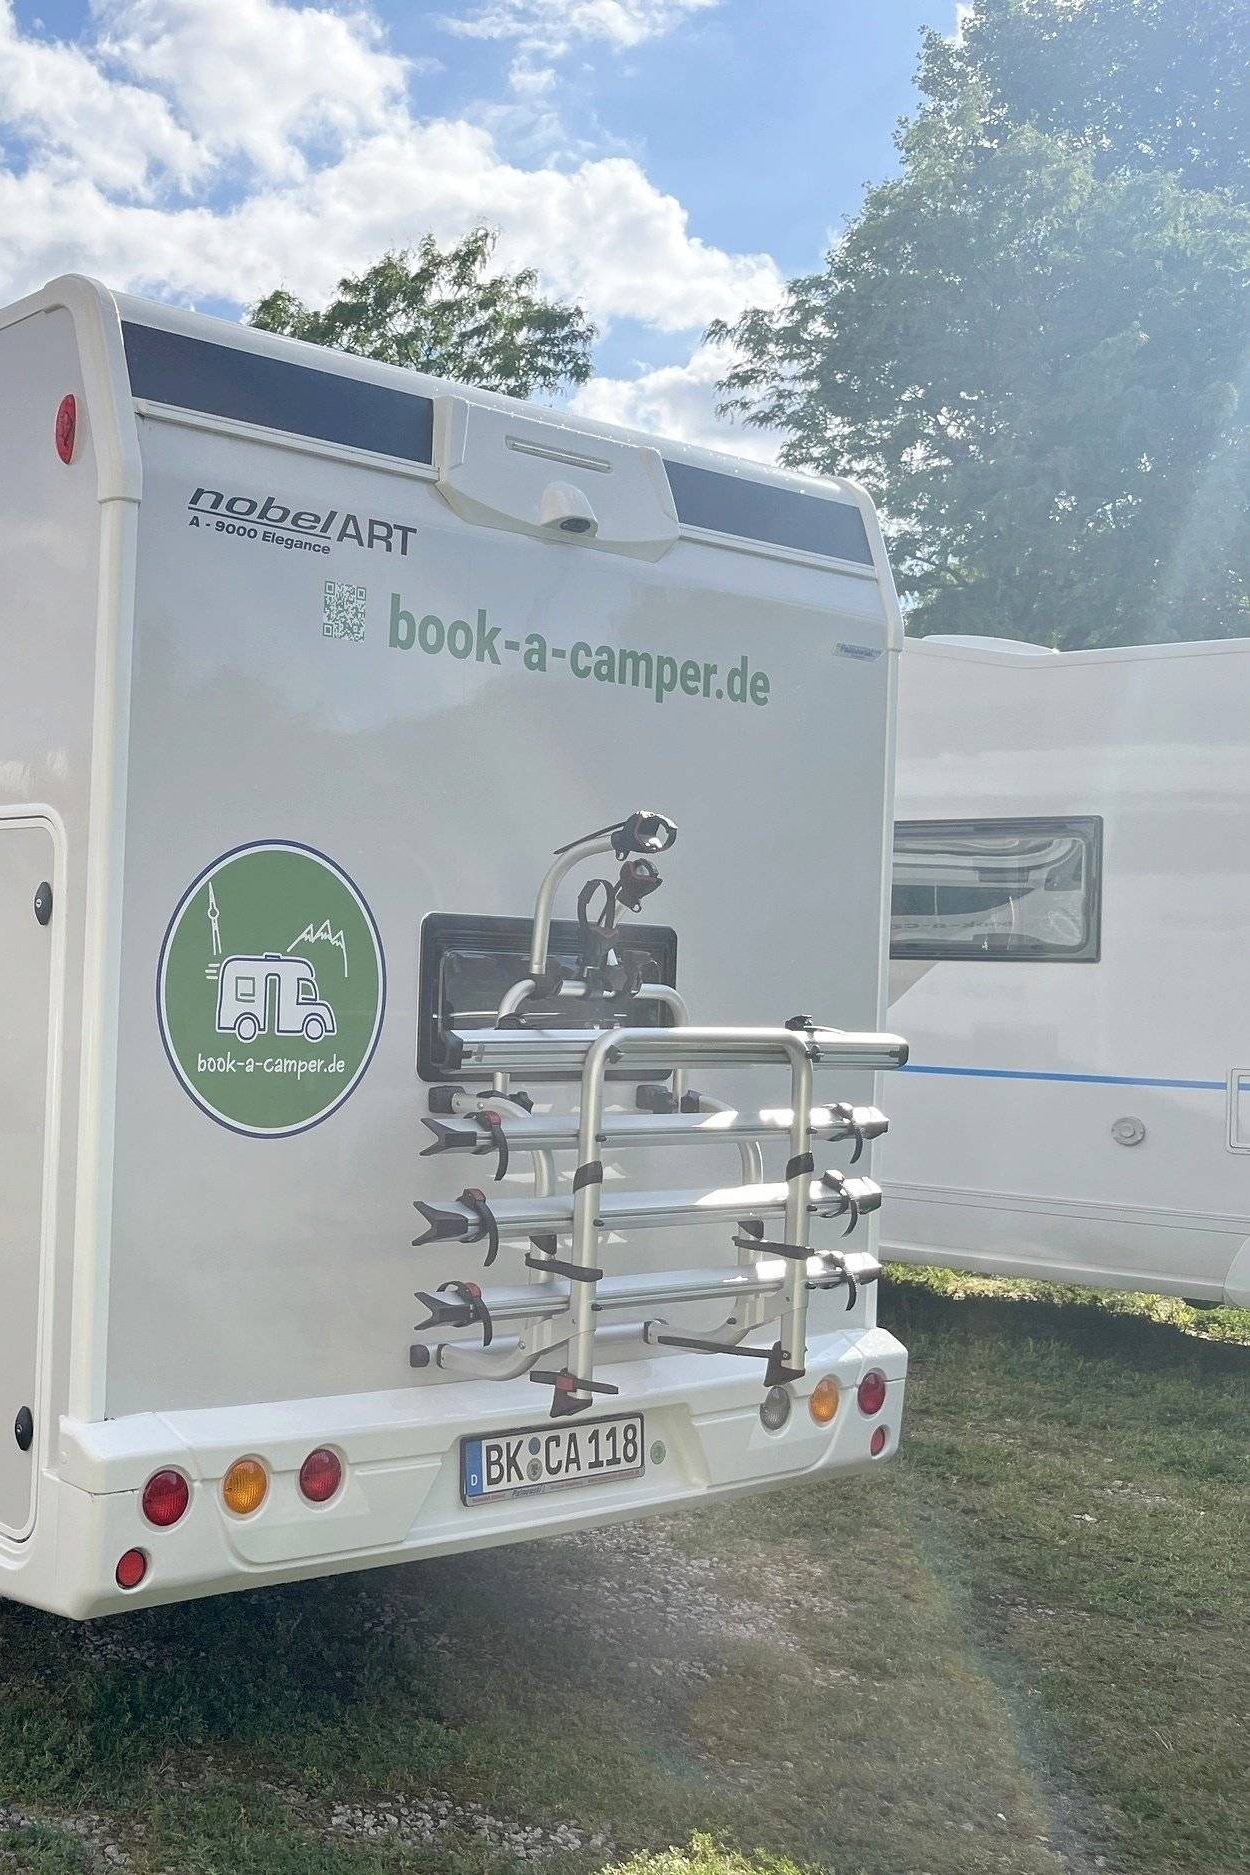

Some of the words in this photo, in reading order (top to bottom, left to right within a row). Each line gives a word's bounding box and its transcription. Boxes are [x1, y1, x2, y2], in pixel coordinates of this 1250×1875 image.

[188, 487, 418, 556] nobelART
[189, 515, 200, 528] A
[214, 520, 258, 540] 9000
[261, 531, 331, 555] Elegance
[387, 592, 771, 707] book-a-camper.de
[197, 1051, 346, 1080] book-a-camper.de
[470, 1474, 478, 1486] D
[485, 1440, 524, 1486] BK
[544, 1432, 581, 1475] CA
[587, 1423, 638, 1469] 118
